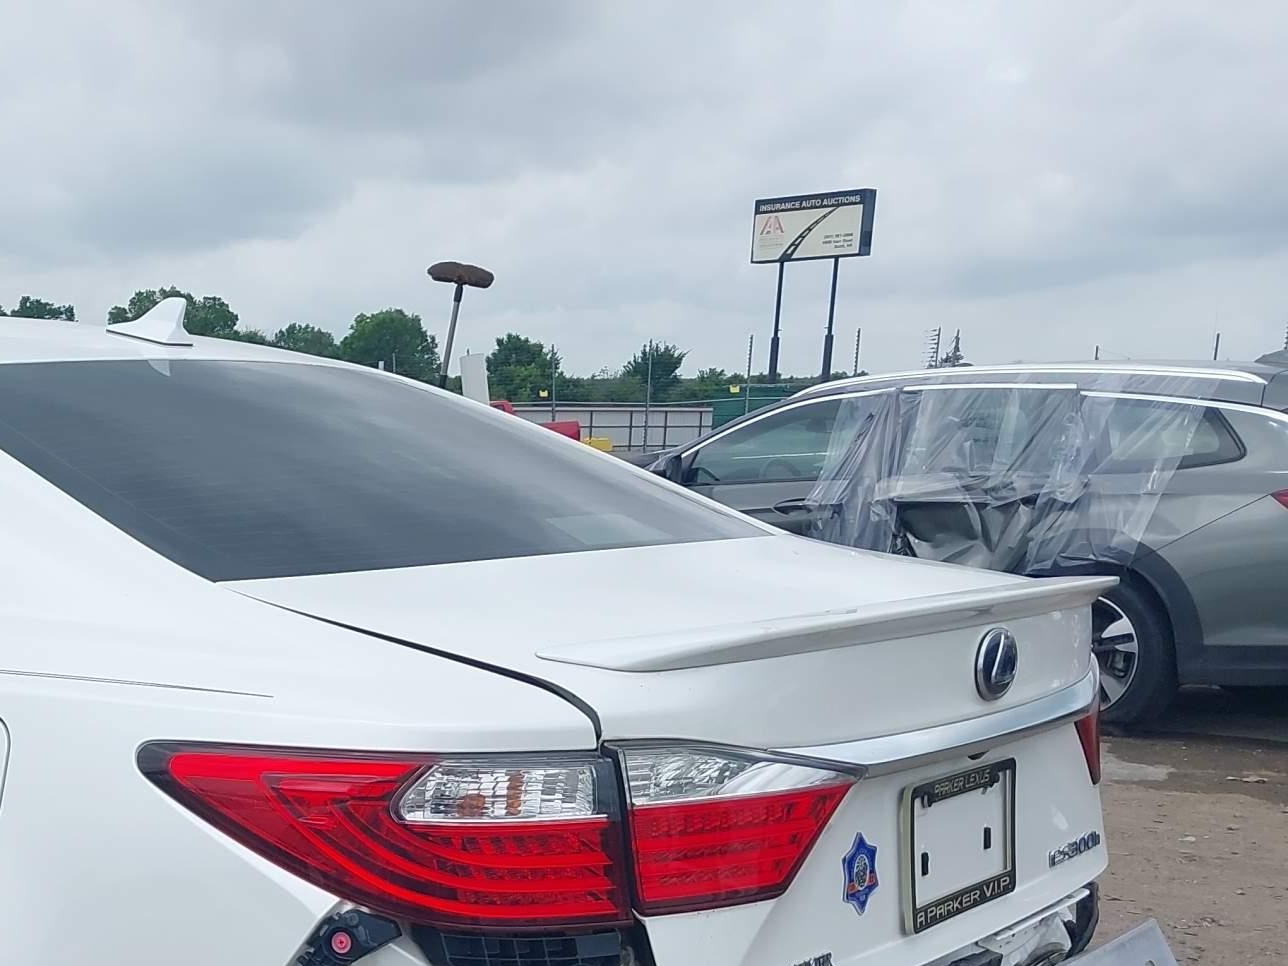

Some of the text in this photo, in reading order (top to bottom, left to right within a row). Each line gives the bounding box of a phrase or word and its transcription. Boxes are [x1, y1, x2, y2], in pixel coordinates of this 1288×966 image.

[759, 195, 861, 212] INSURANCE AUTO AUCTIONS
[934, 777, 965, 796] PARKER
[916, 876, 1012, 929] A PARKER V.I.P.
